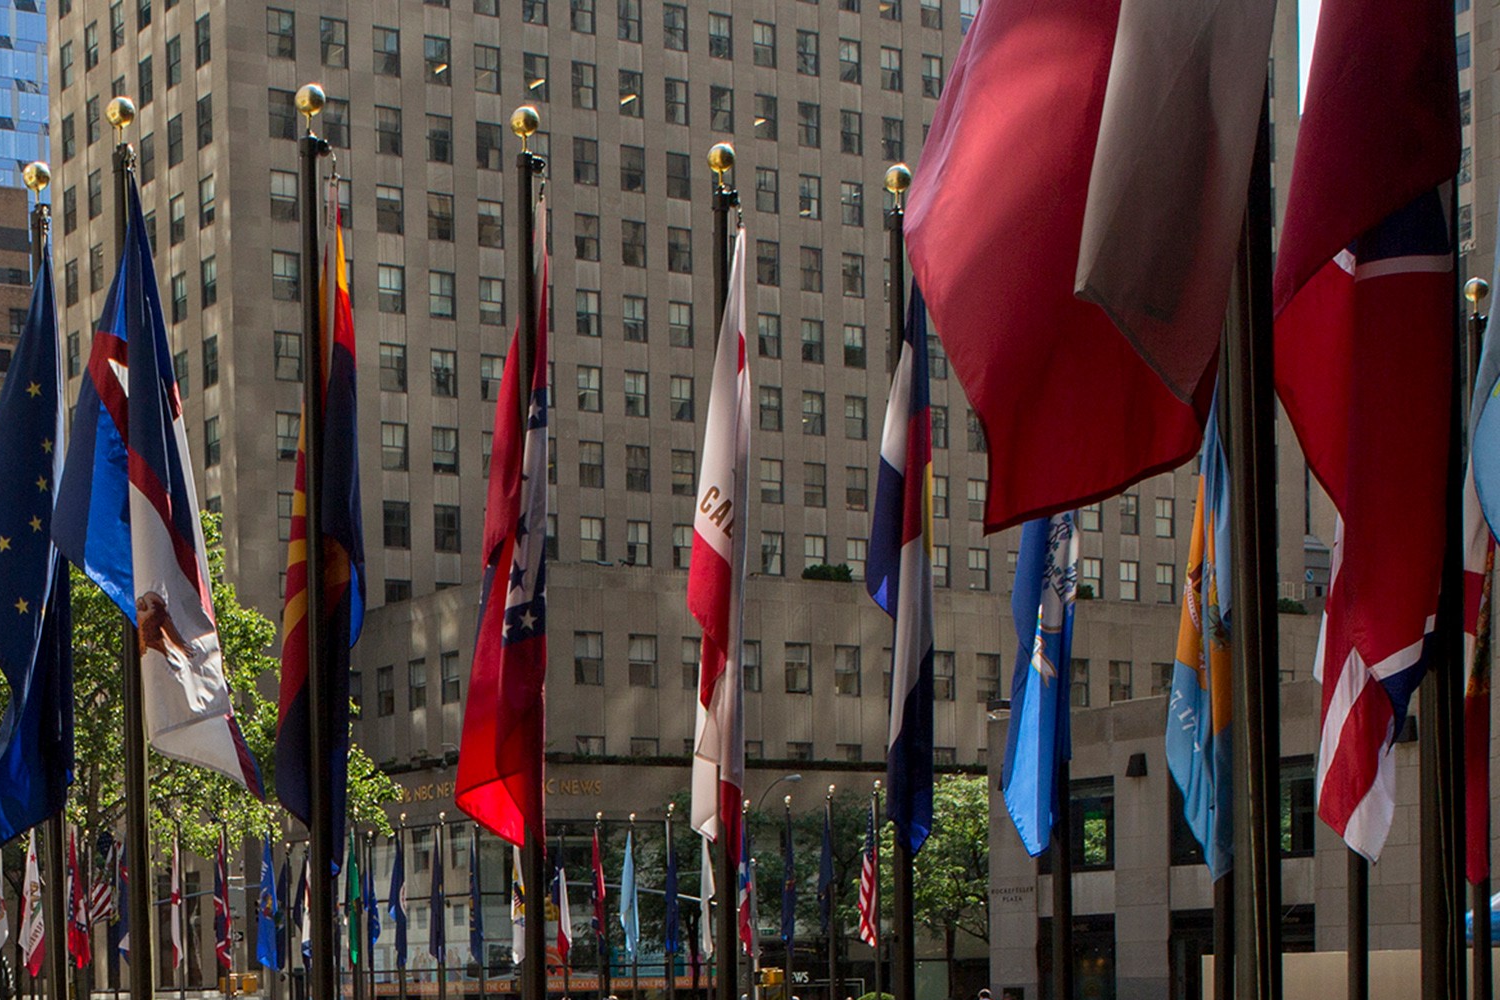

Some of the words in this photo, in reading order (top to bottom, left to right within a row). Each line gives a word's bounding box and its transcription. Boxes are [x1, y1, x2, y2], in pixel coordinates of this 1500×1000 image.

[413, 784, 434, 801] NBC
[559, 779, 601, 796] NEWS
[991, 886, 1034, 895] ROCKEFELLER
